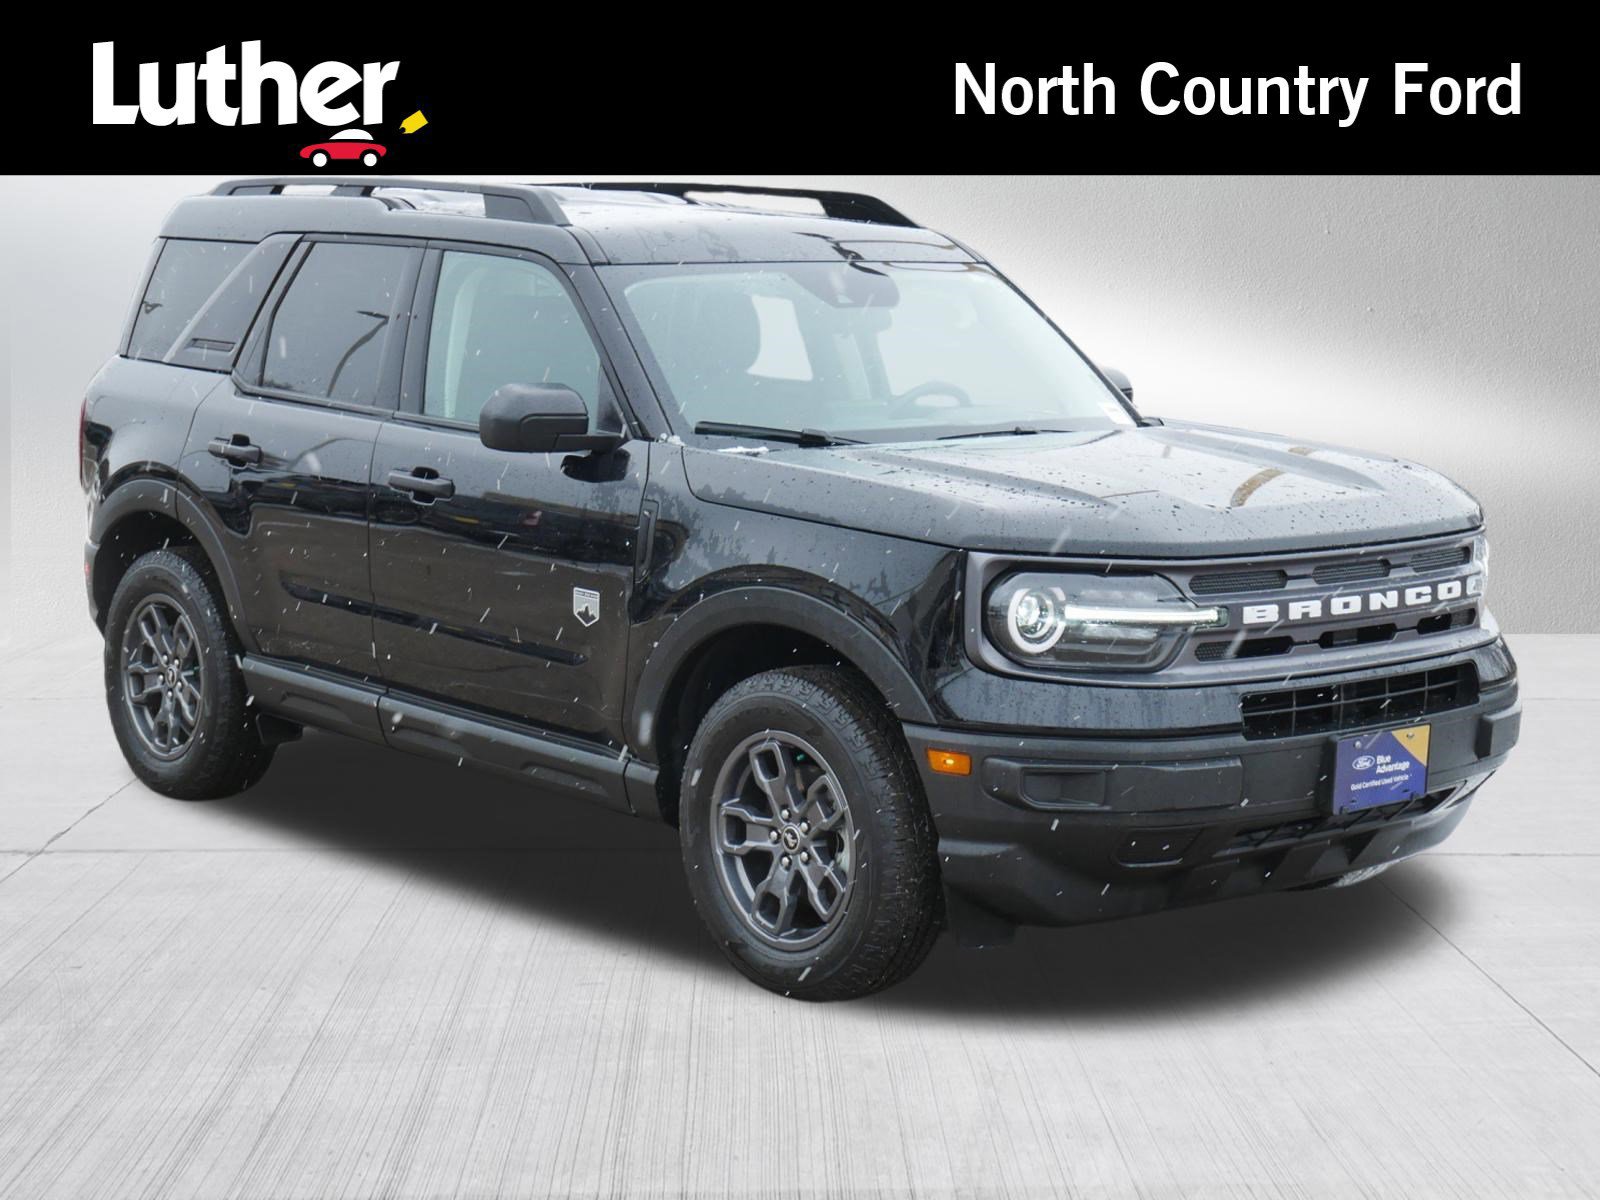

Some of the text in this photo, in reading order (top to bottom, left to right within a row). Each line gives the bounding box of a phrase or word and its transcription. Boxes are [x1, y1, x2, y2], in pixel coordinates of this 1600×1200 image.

[1242, 580, 1462, 625] BRONCO
[1376, 755, 1391, 764] Blue
[1376, 761, 1410, 774] Advantage
